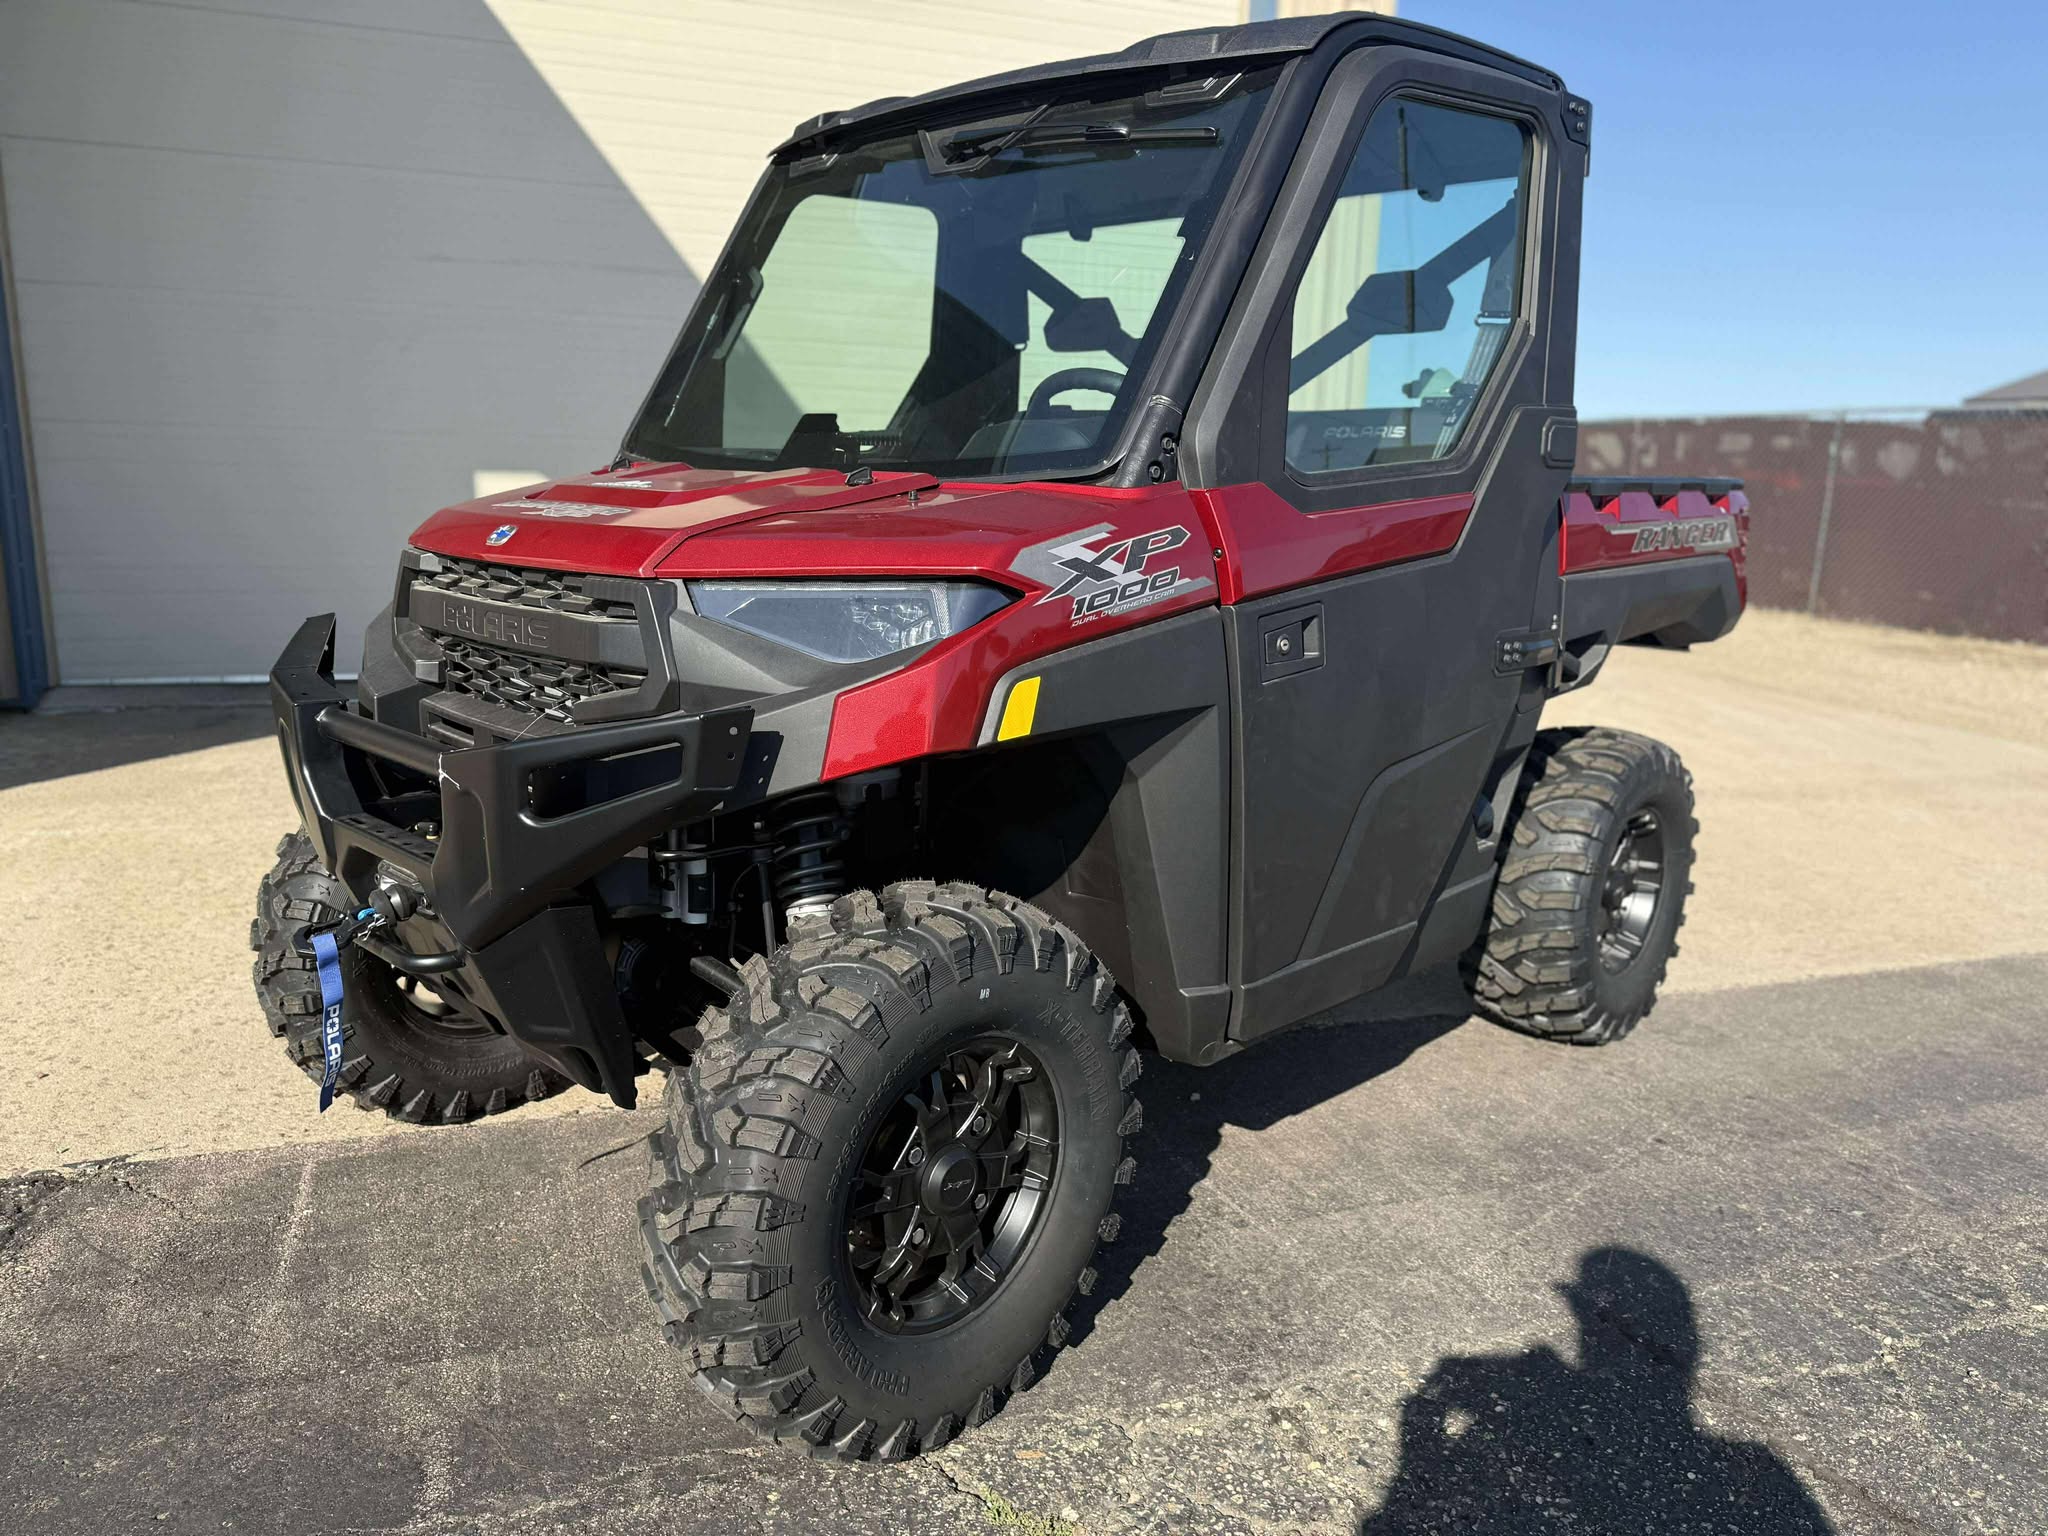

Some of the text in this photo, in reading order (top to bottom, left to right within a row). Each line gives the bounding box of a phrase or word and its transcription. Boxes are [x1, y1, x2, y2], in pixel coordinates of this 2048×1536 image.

[1323, 425, 1407, 439] POLARIS
[1631, 521, 1729, 553] RANGER
[1033, 525, 1191, 606] XP
[1070, 566, 1180, 620] 1000
[1071, 588, 1175, 628] DUAL OVERHEAD CAM
[443, 600, 550, 649] POLARIS
[325, 1004, 340, 1088] POLARIS
